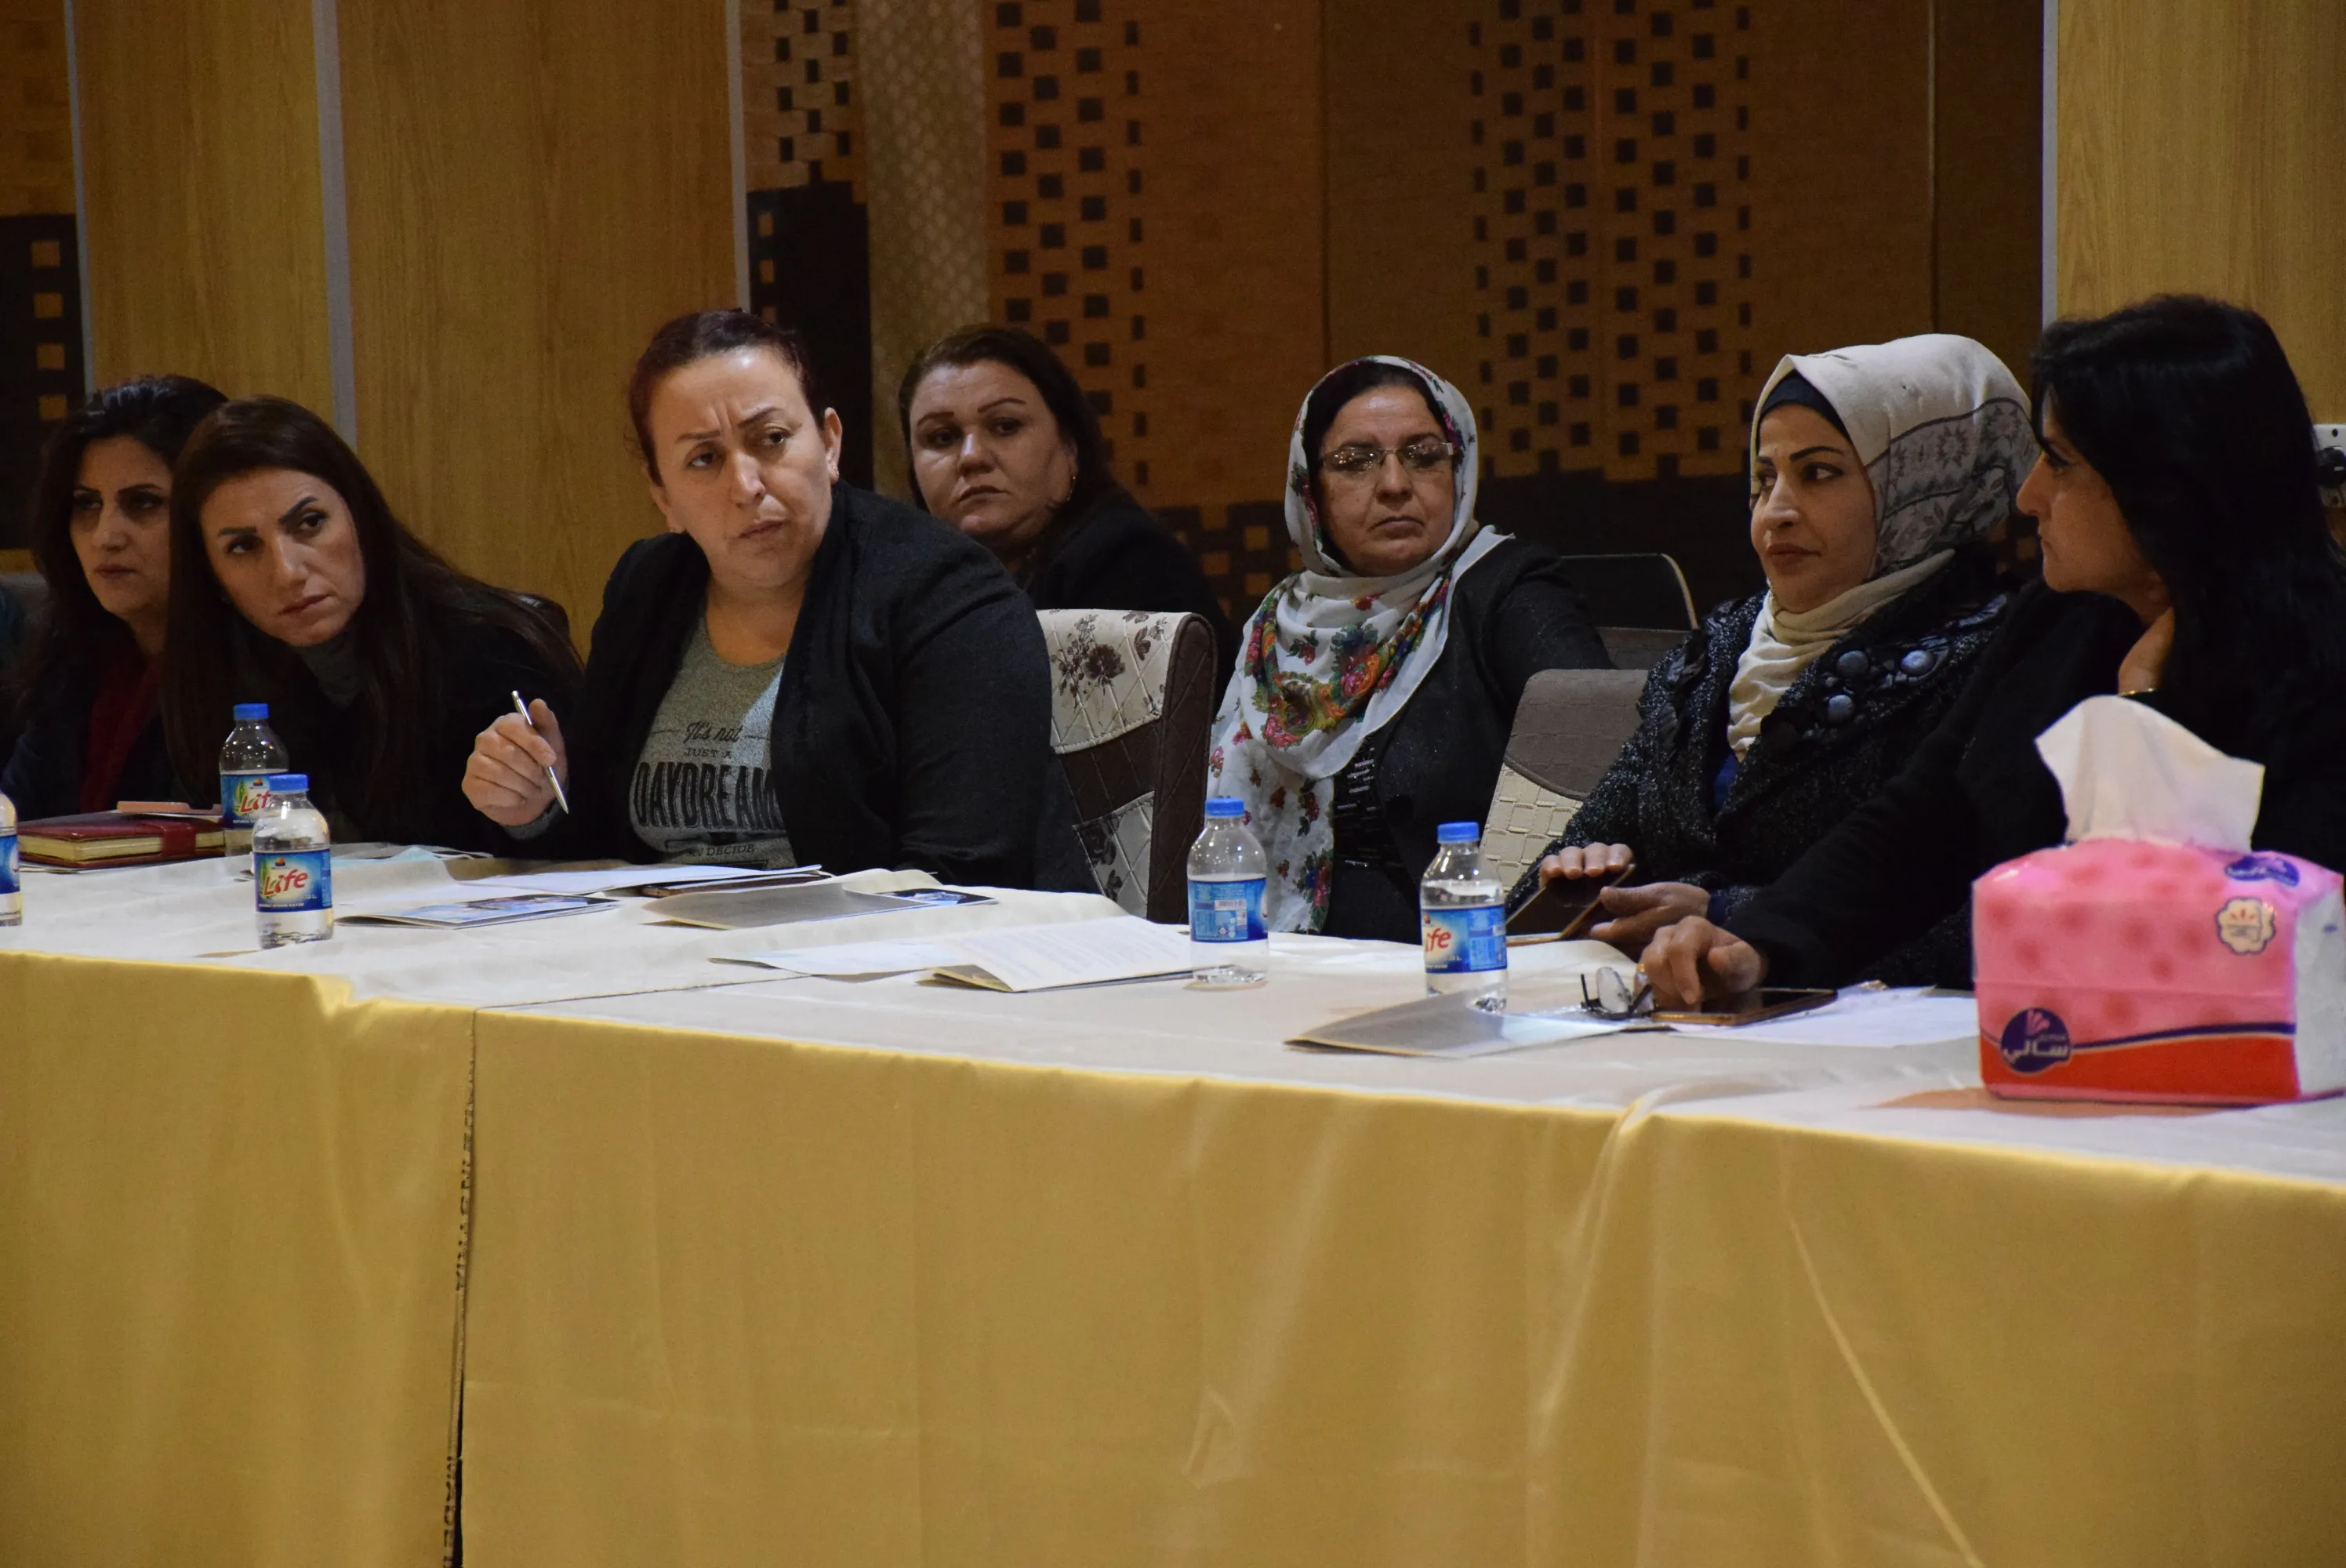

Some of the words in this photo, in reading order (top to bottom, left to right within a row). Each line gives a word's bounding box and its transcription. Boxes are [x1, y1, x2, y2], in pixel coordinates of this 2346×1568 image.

[713, 724, 743, 742] not
[683, 747, 718, 757] JUST
[721, 749, 732, 759] A
[240, 790, 272, 813] Lif
[706, 844, 755, 856] DECIDE
[263, 869, 308, 895] Life
[1425, 928, 1452, 953] ife
